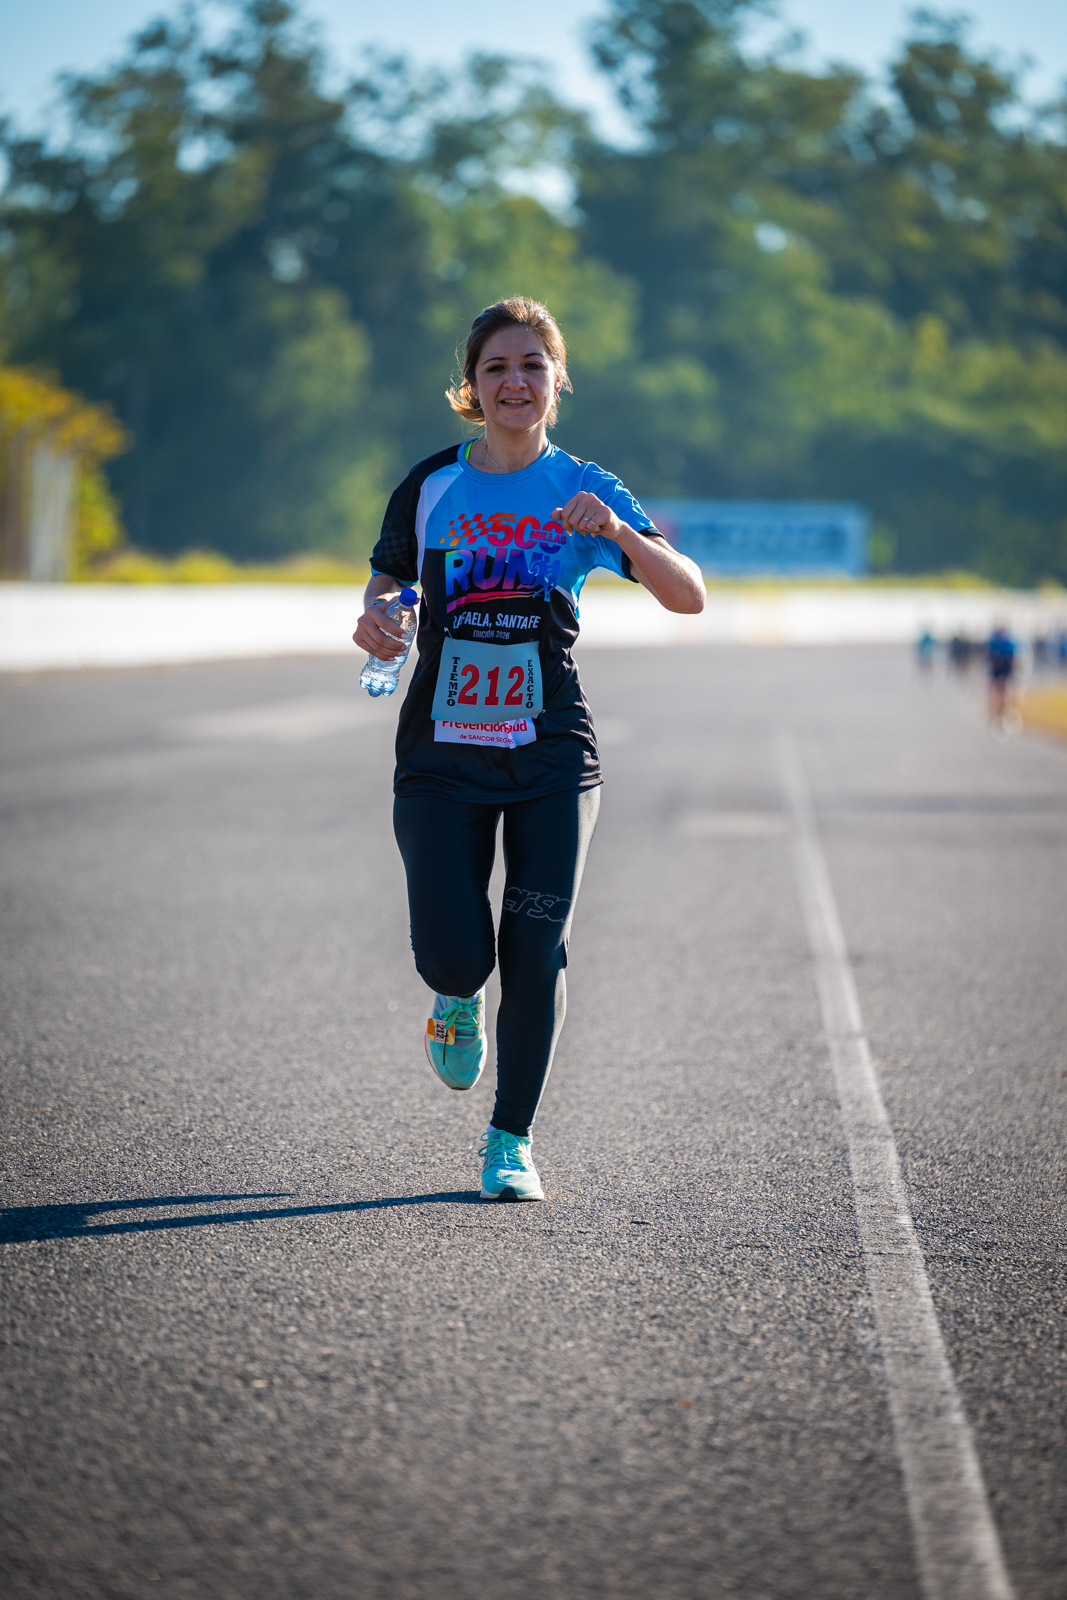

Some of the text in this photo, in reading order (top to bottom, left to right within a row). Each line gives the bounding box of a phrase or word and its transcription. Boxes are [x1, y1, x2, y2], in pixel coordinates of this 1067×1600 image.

[487, 512, 564, 554] 500
[529, 529, 567, 545] MILLAS
[445, 547, 543, 597] RUN
[447, 656, 460, 707] TIEMPO
[457, 663, 525, 706] 212
[526, 659, 535, 709] EXACTO
[468, 734, 495, 742] SANCOR
